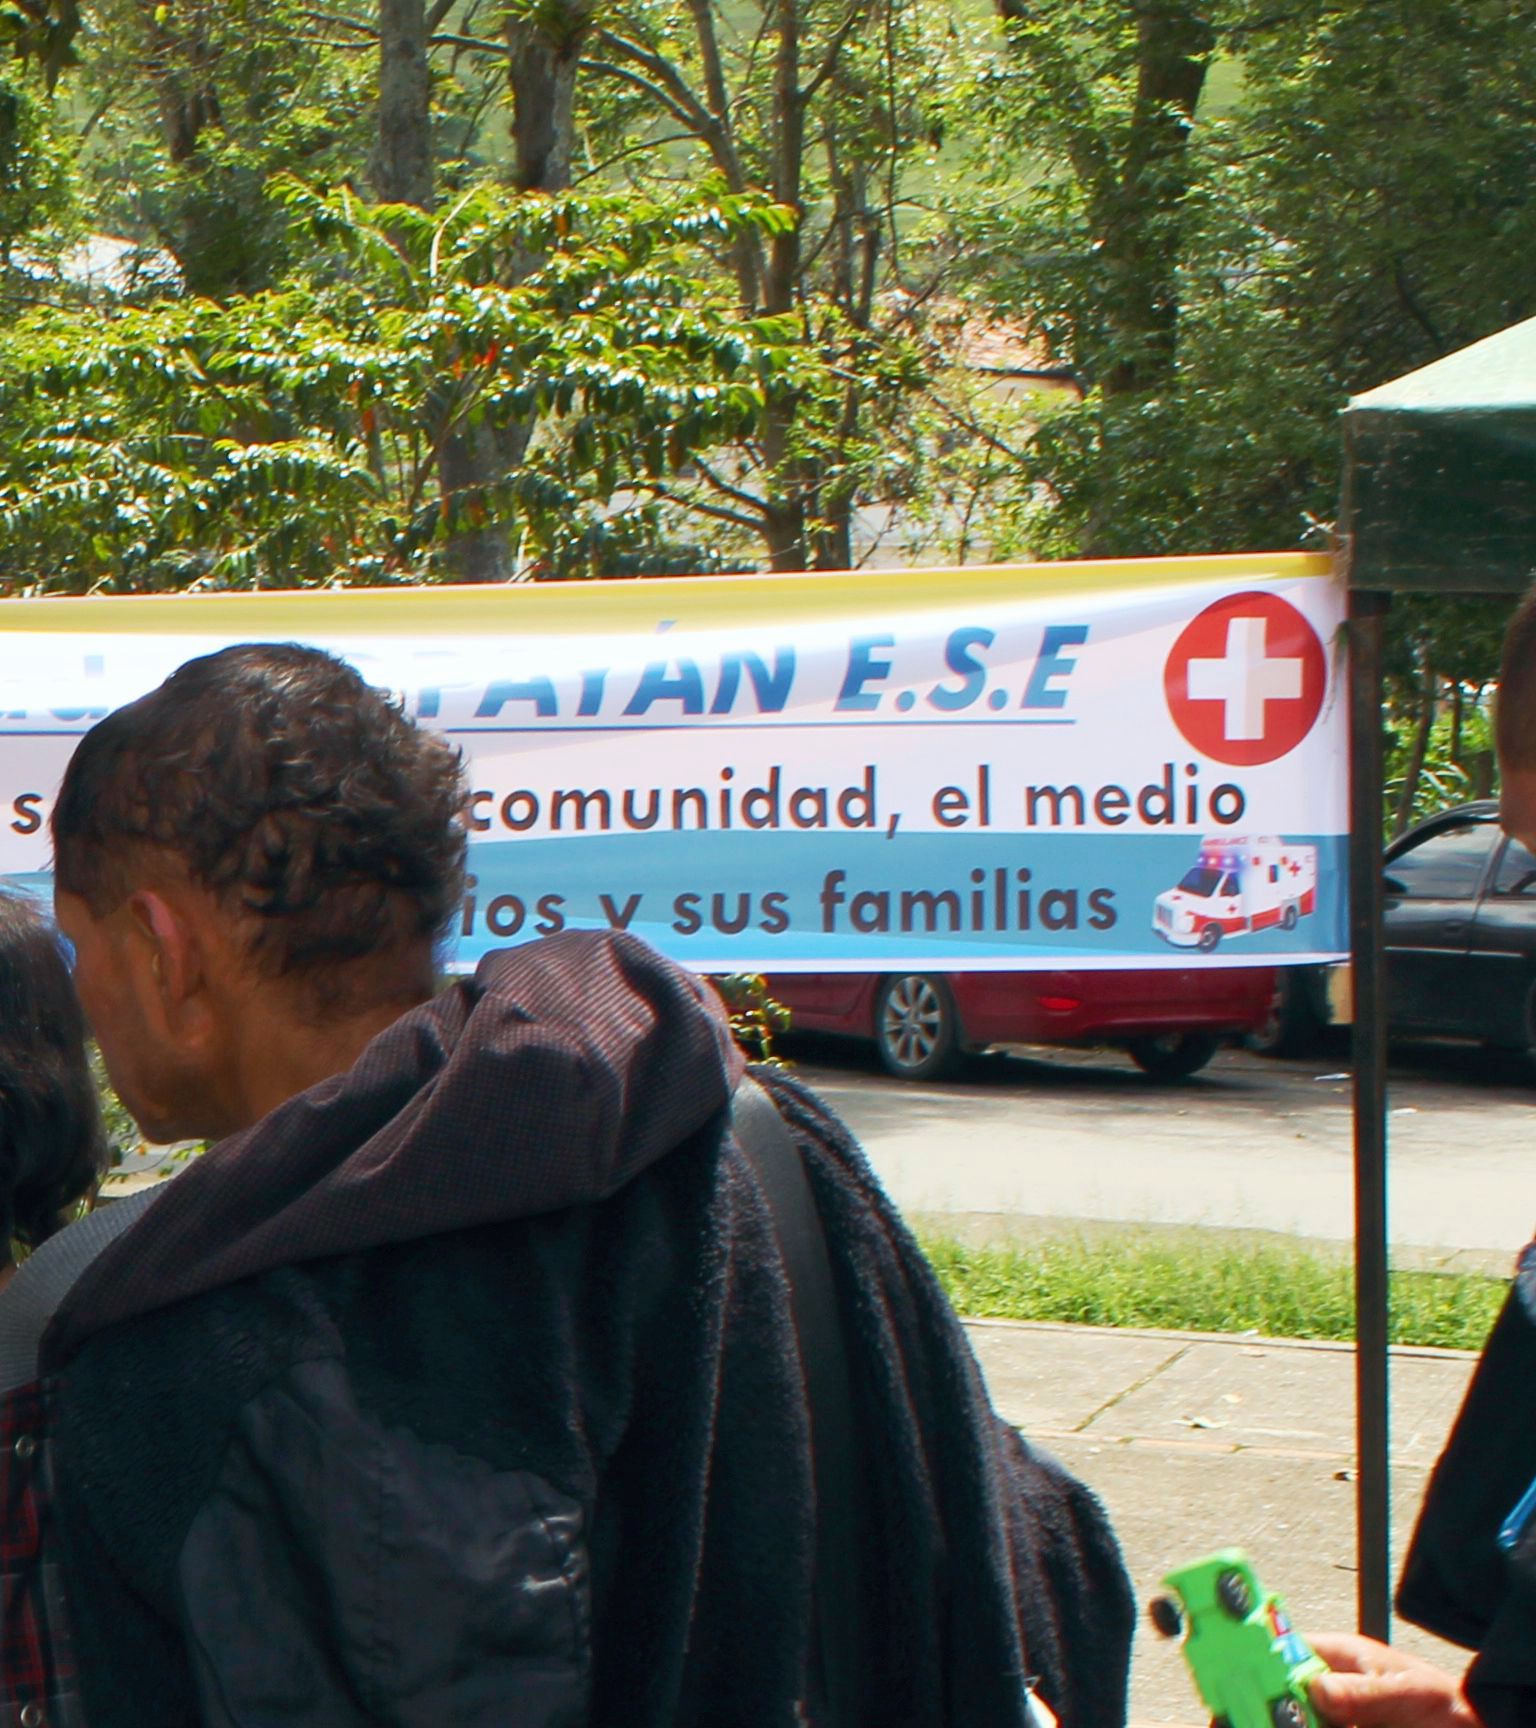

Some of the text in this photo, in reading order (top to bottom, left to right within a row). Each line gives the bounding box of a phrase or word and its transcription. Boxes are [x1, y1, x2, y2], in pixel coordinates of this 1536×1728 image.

[833, 625, 1090, 713] E.S.E
[465, 765, 902, 839] comunidad,
[932, 764, 991, 827] el
[1025, 762, 1246, 827] medio
[672, 892, 791, 935] sus
[819, 867, 1118, 933] familias
